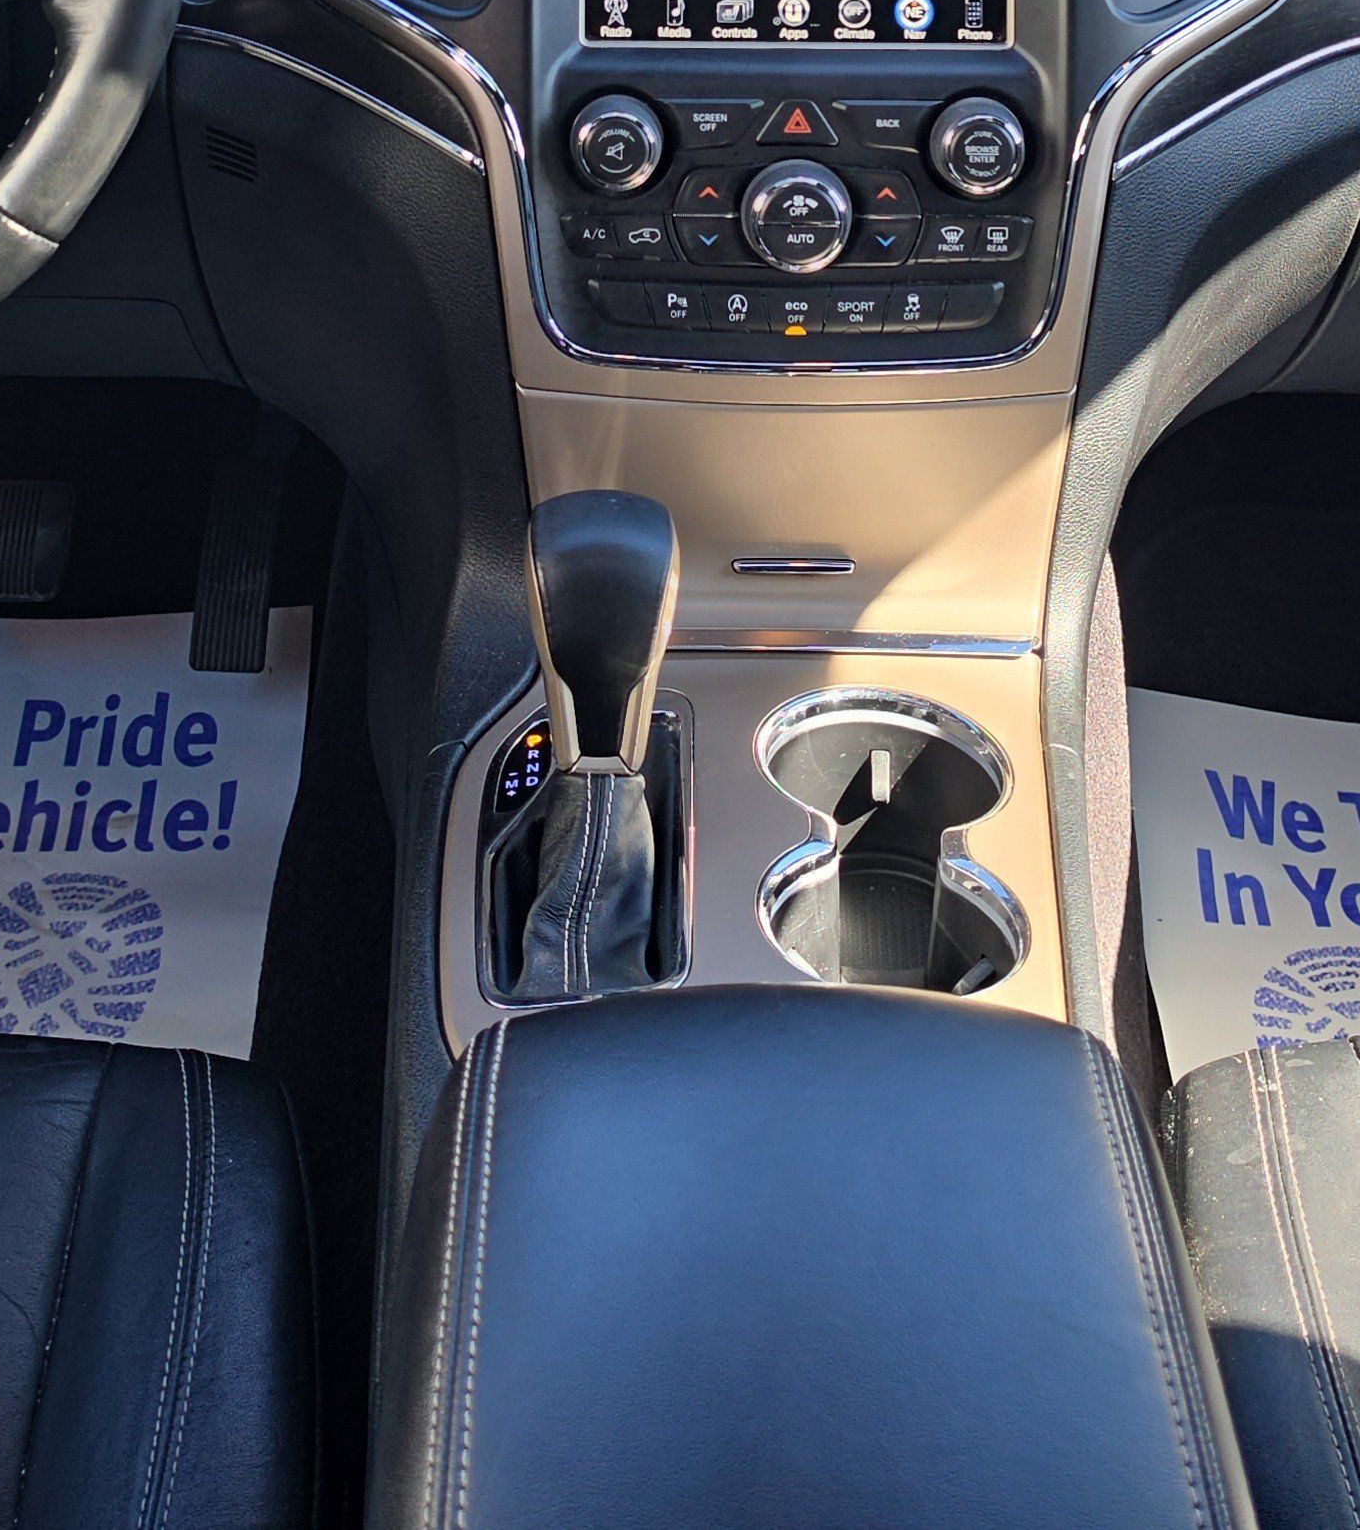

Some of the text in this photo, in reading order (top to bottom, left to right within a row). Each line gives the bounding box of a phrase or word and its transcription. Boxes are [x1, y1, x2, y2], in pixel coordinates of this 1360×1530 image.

[904, 7, 926, 19] NE
[599, 26, 633, 39] Radio
[657, 26, 692, 39] Media
[712, 26, 758, 39] Controls
[778, 27, 809, 41] Apps
[833, 27, 876, 40] Climate
[903, 29, 928, 40] Nav
[957, 27, 994, 40] Phone
[693, 113, 728, 124] SCREEN
[876, 118, 900, 129] BACK
[699, 122, 717, 132] OFF
[599, 128, 631, 140] VOLUME
[965, 145, 1000, 155] BROWSE
[968, 154, 996, 164] ENTER
[789, 206, 810, 217] OFF
[583, 226, 606, 240] A/C
[786, 233, 815, 244] AUTO
[937, 243, 964, 253] FRONT
[986, 243, 1008, 253] REAR
[784, 301, 808, 312] eco
[837, 301, 875, 313] SPORT
[670, 309, 687, 319] OFF
[728, 312, 746, 322] OFF
[787, 314, 805, 323] OFF
[849, 313, 864, 323] ON
[903, 311, 921, 321] OFF
[13, 691, 219, 770] Pride
[527, 749, 540, 760] R
[526, 762, 540, 773] N
[505, 779, 519, 789] M
[525, 776, 539, 787] D
[1204, 769, 1327, 853] We
[1196, 847, 1272, 927] In
